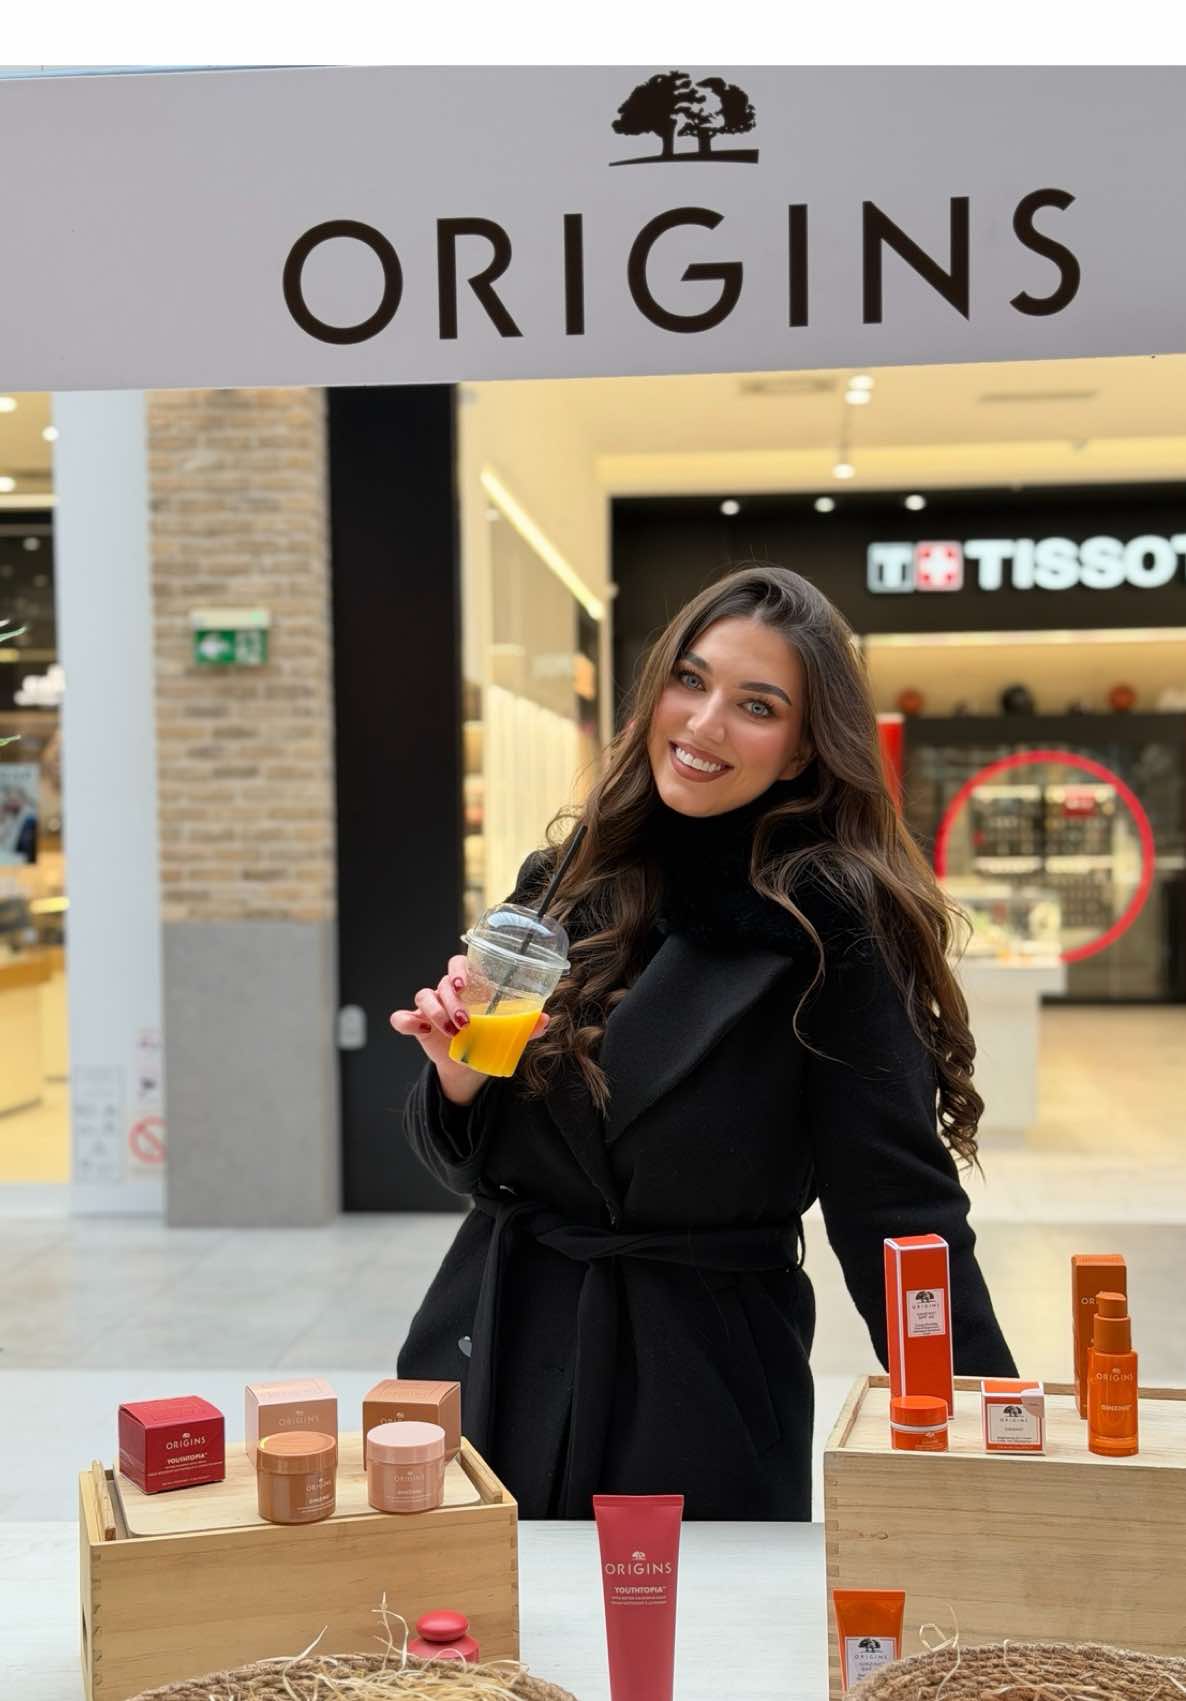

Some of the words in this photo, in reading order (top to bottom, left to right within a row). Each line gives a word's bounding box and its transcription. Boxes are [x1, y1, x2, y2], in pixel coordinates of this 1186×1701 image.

[282, 188, 1082, 345] ORIGINS
[964, 534, 1186, 591] TISSO
[166, 1436, 207, 1450] ORIGINS
[604, 1561, 673, 1576] ORIGINS
